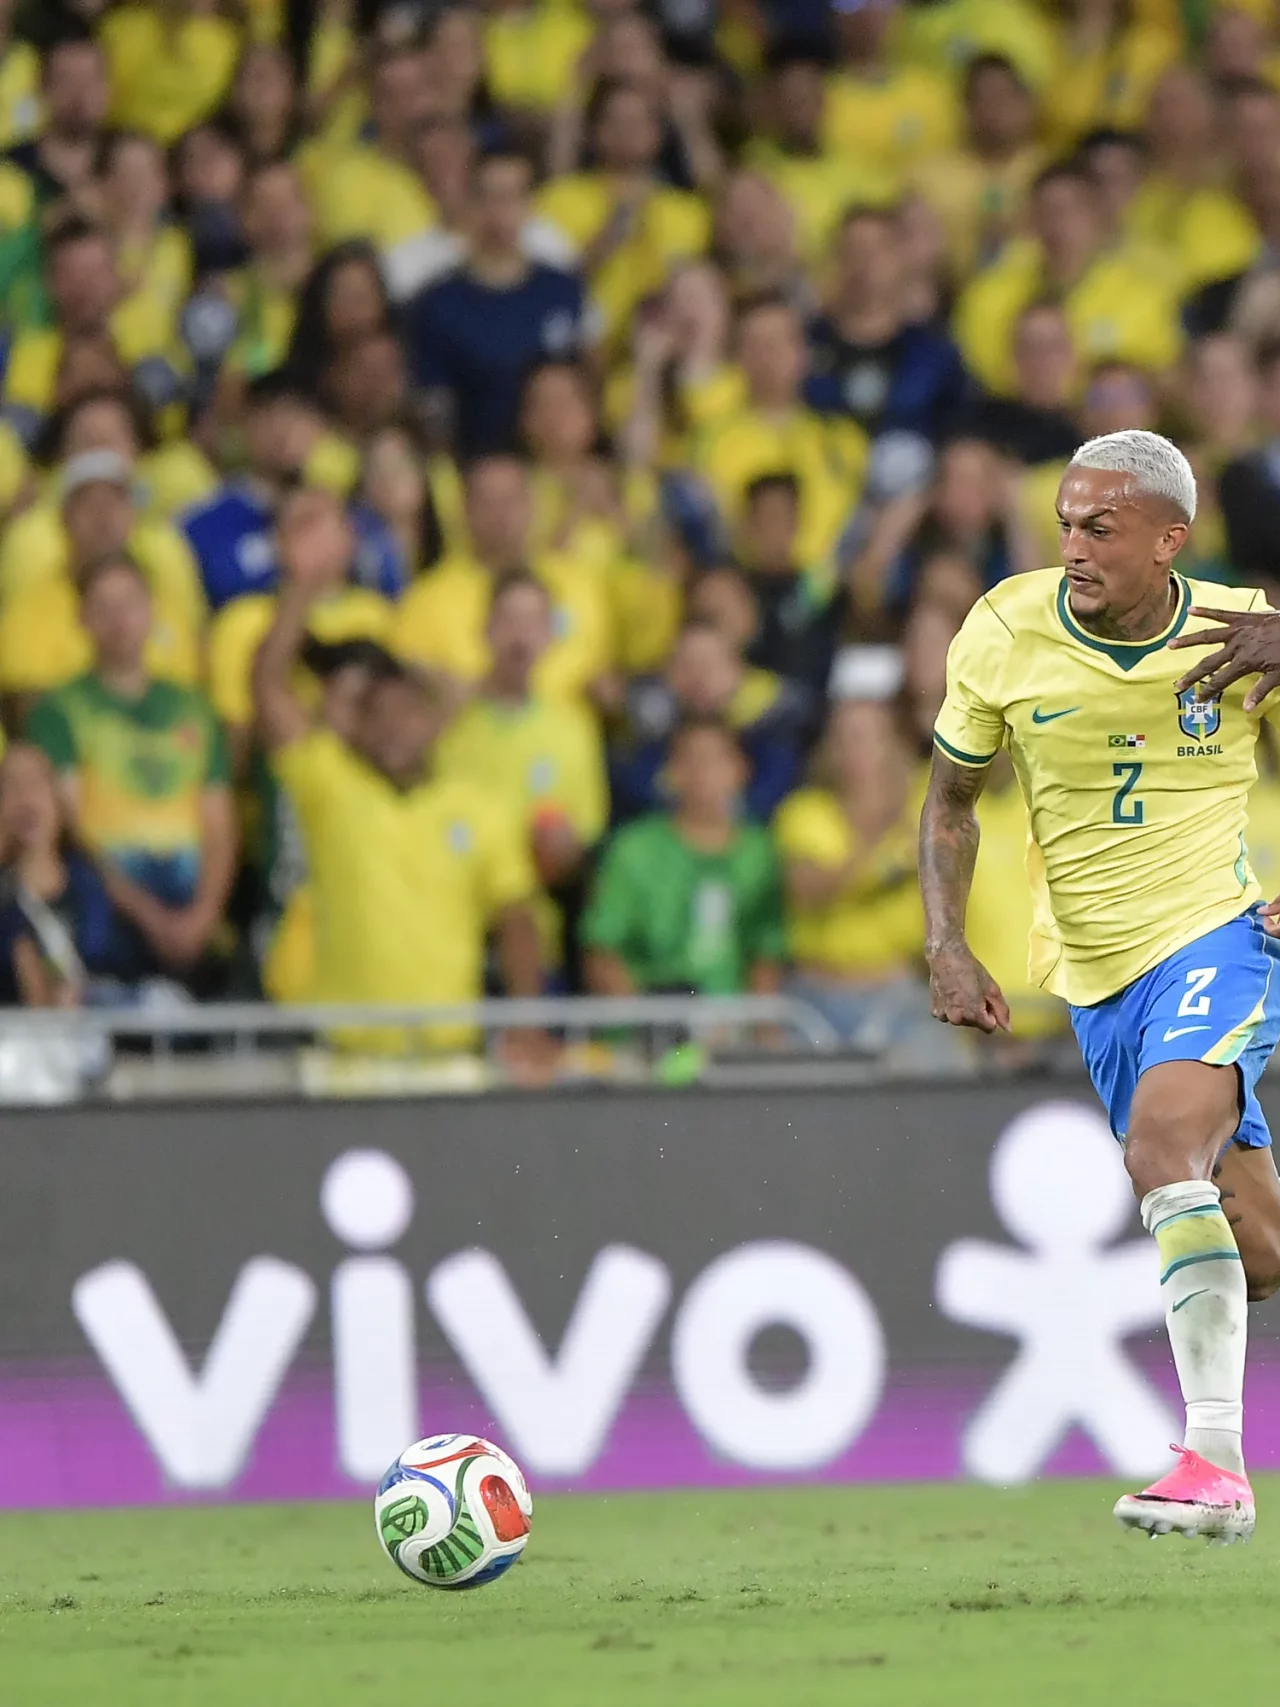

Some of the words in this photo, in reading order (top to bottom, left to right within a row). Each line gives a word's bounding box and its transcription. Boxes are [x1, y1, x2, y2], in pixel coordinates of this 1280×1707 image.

[1190, 705, 1208, 714] CBF
[1177, 744, 1223, 757] BRASIL
[1112, 762, 1144, 824] 2
[1177, 965, 1219, 1018] 2
[75, 1149, 886, 1490] vivo
